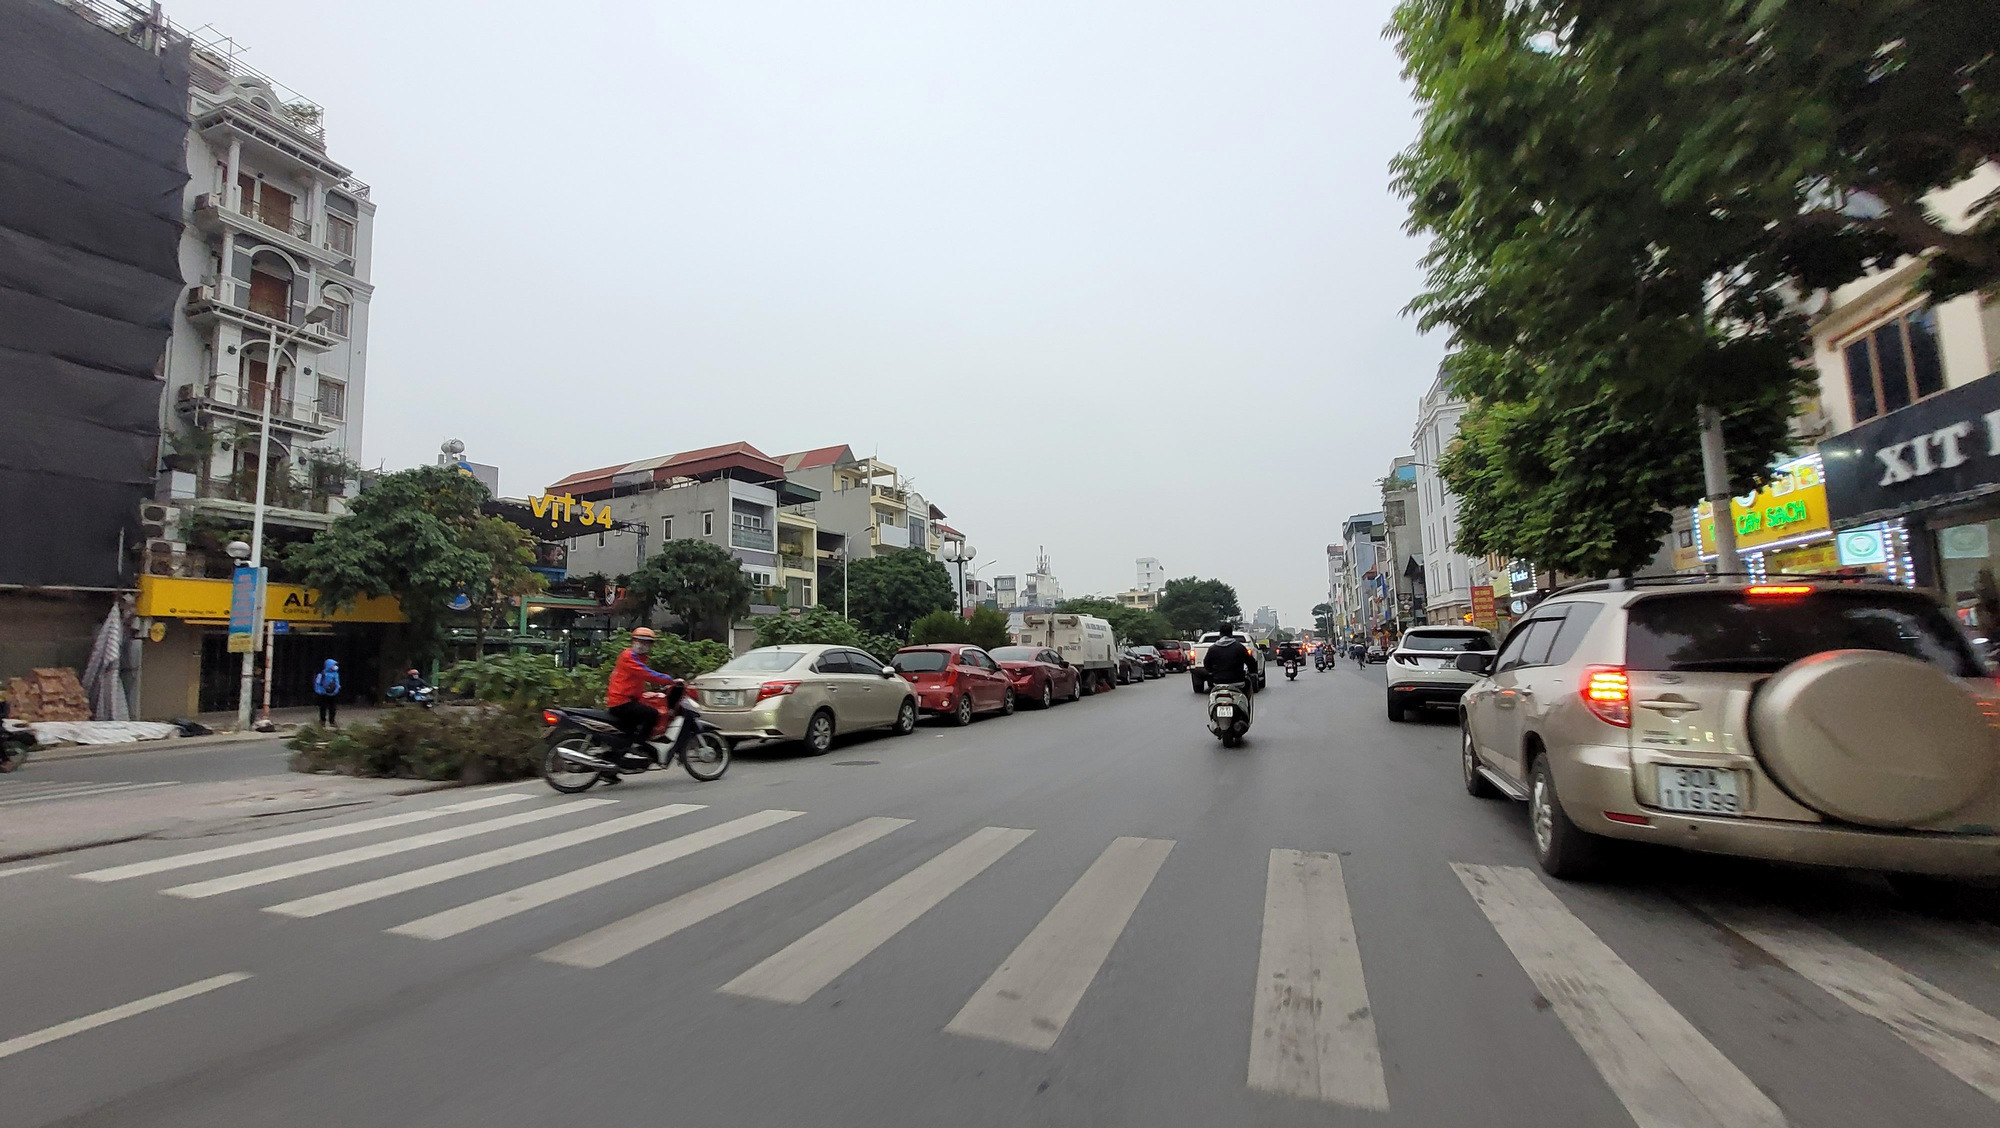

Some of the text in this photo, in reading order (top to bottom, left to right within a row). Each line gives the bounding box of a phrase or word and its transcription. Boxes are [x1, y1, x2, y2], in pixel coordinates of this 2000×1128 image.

[1876, 420, 1974, 487] XIT
[579, 501, 613, 529] 34
[1765, 499, 1807, 530] SẠCH
[1676, 768, 1717, 788] 30A
[1665, 788, 1736, 812] 11999
